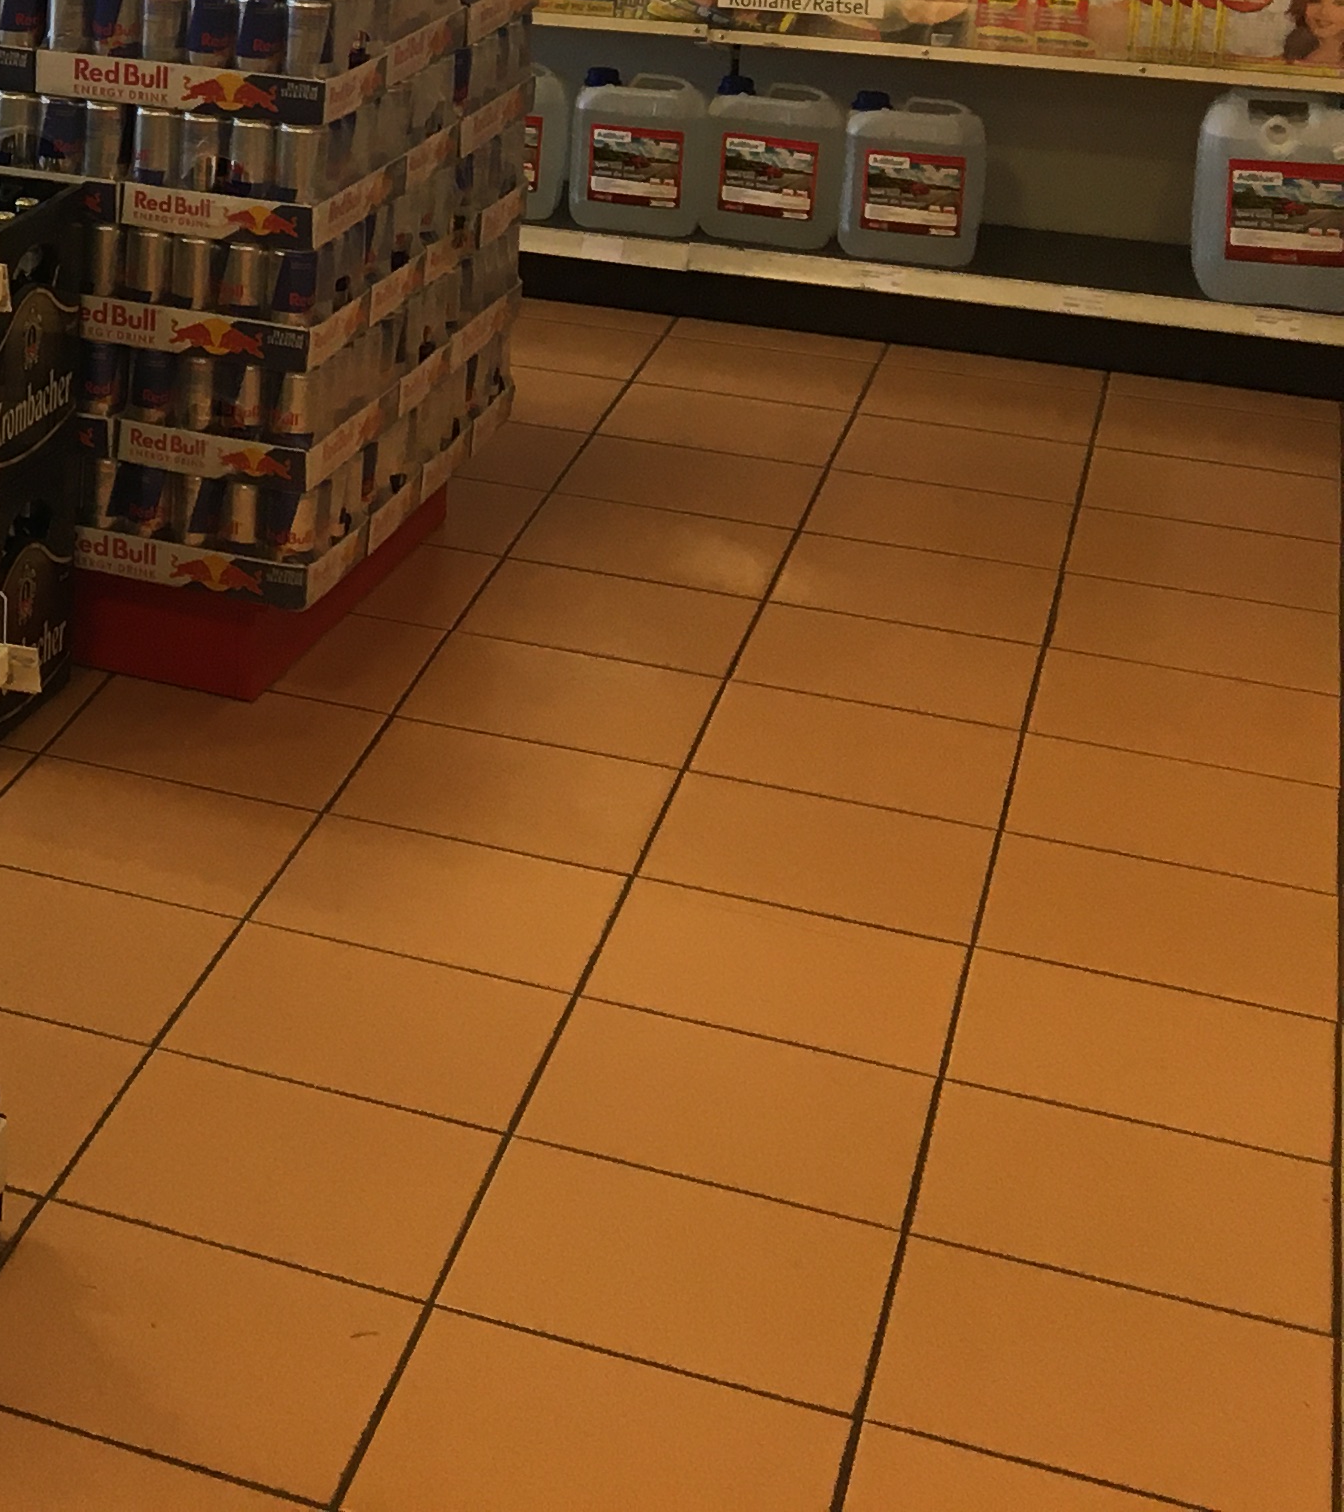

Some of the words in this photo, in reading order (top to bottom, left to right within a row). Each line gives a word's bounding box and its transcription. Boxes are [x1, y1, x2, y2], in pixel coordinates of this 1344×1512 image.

[73, 58, 121, 86] Red
[123, 63, 170, 90] Bull
[73, 84, 124, 99] ENERGY
[126, 89, 169, 104] DRINK
